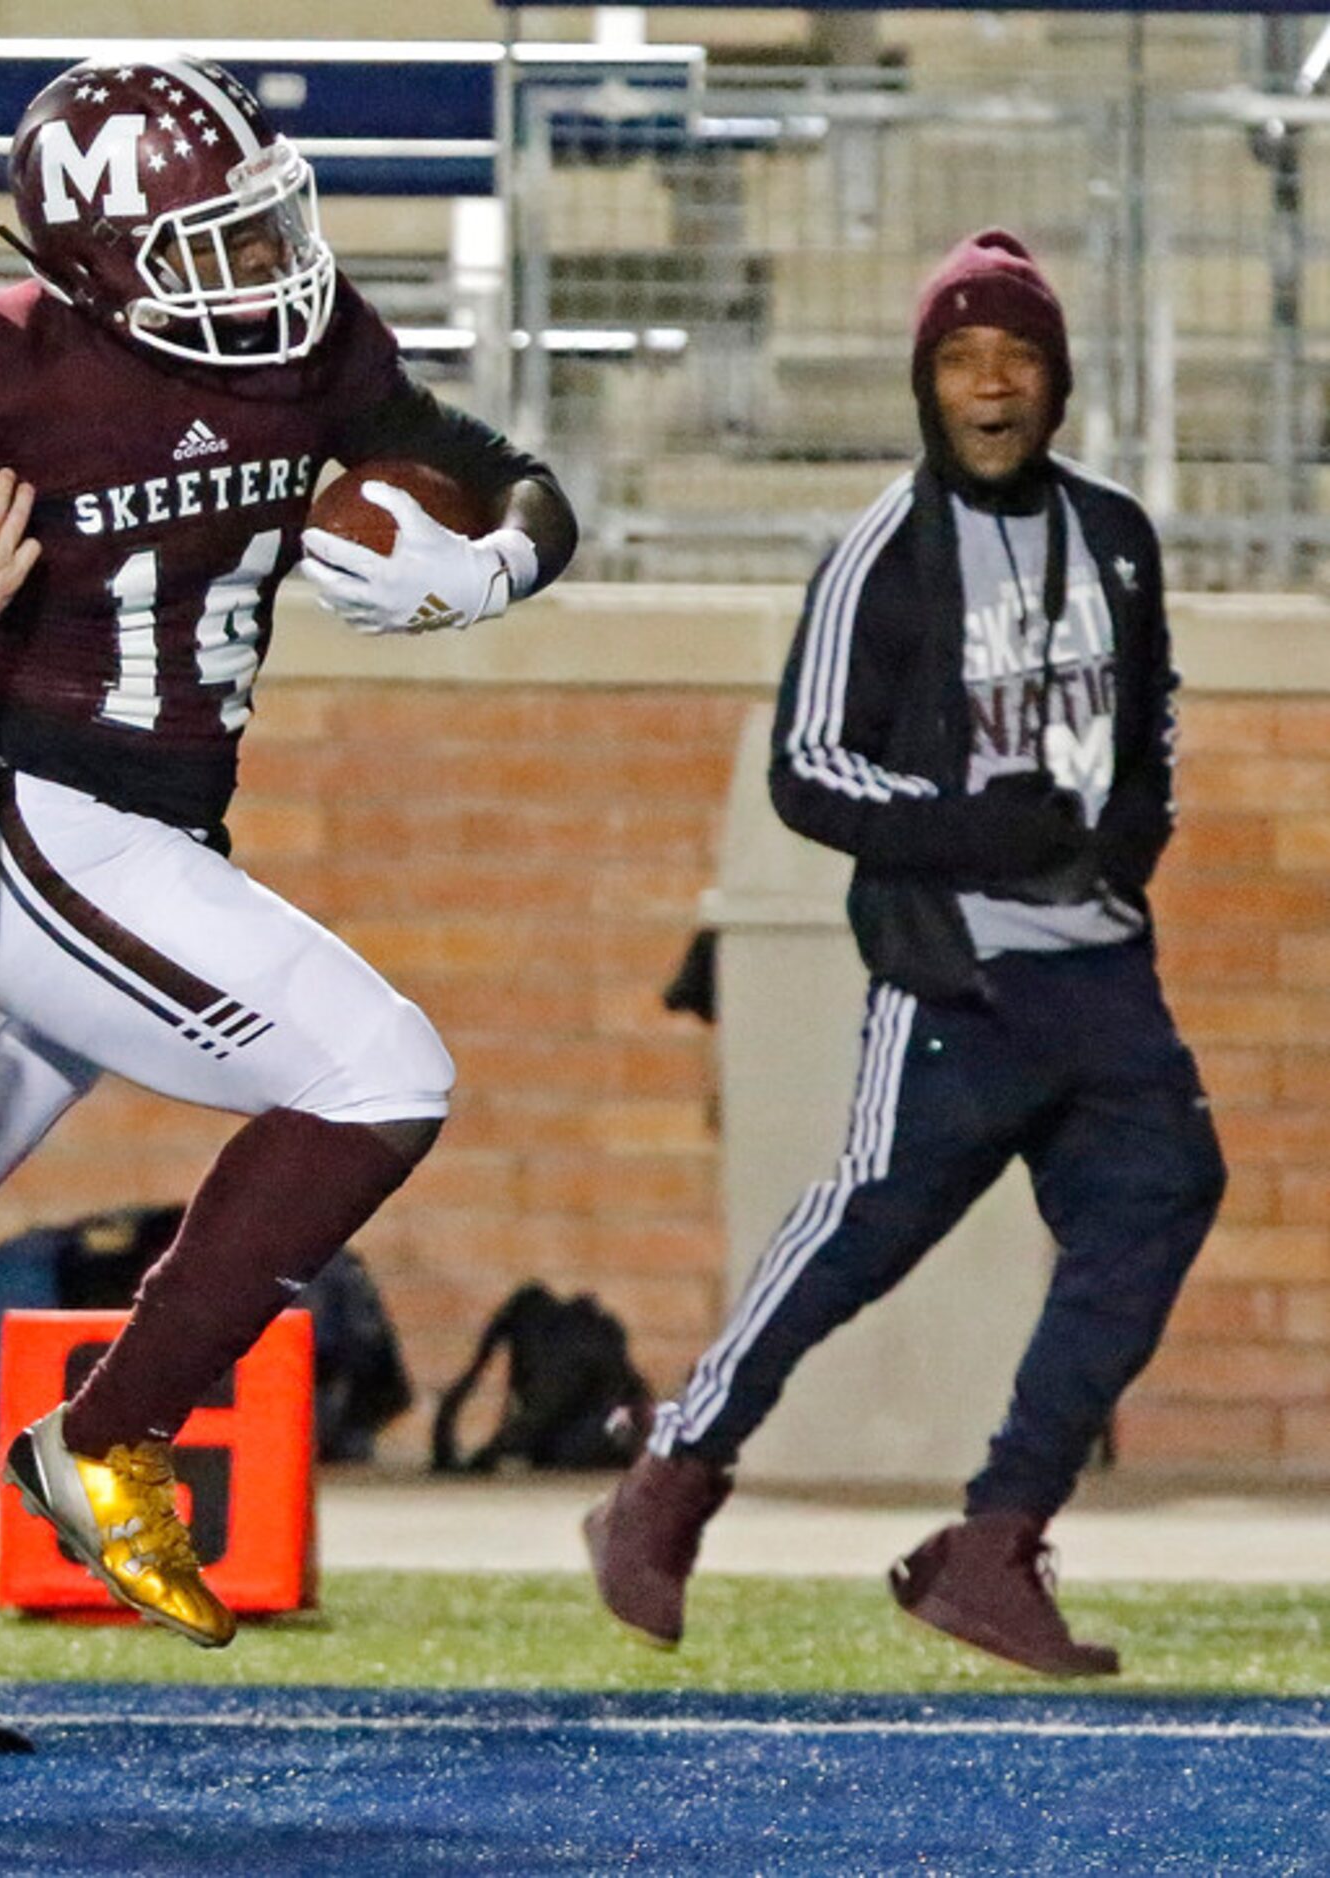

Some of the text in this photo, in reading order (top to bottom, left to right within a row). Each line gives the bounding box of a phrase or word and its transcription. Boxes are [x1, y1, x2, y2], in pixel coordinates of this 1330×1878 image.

[39, 113, 149, 223] M
[74, 454, 311, 535] SKEETERS
[100, 528, 283, 733] 14
